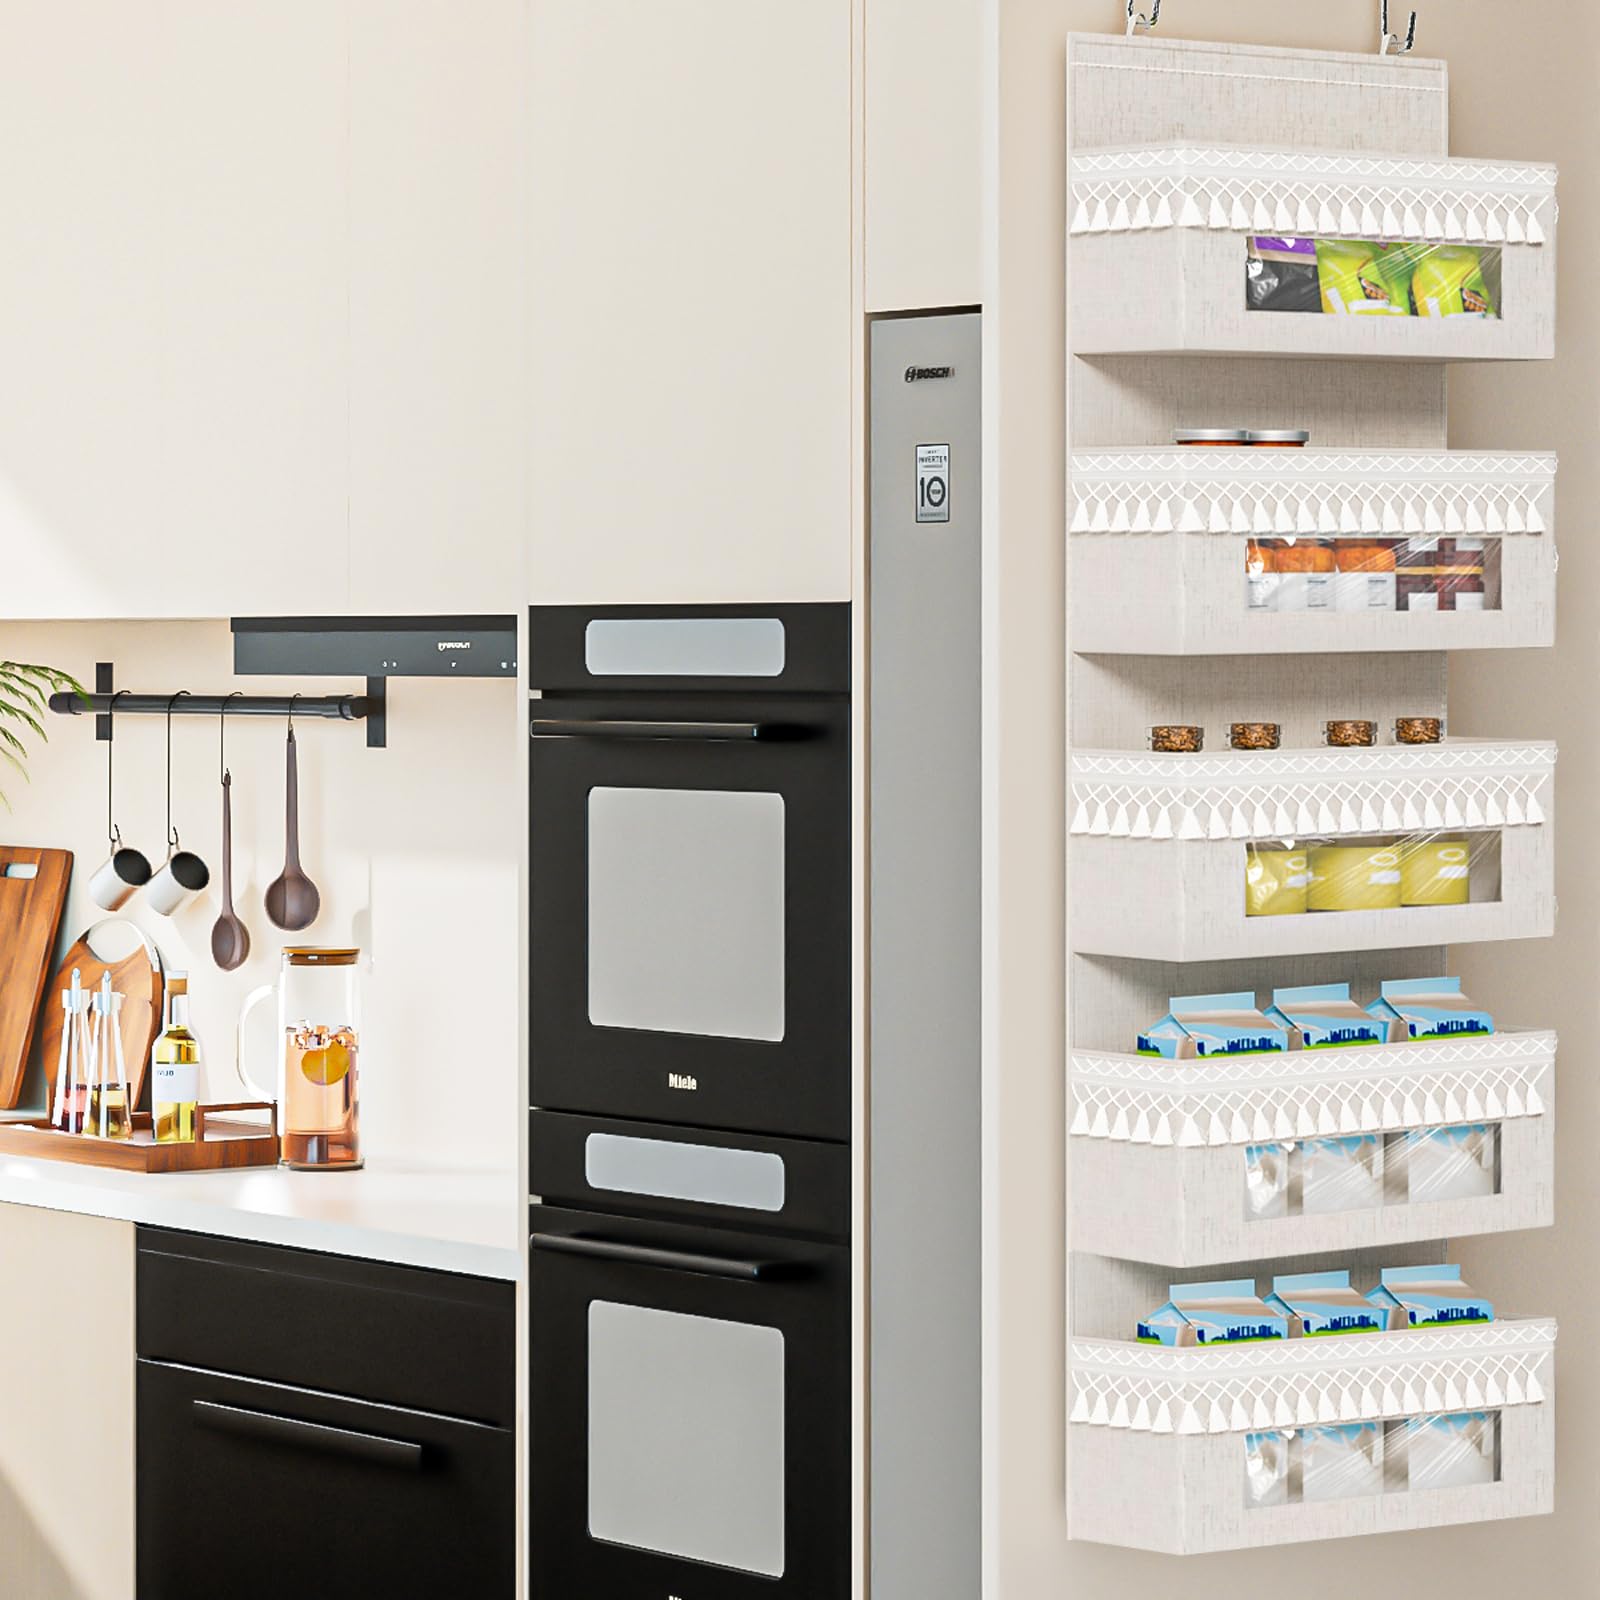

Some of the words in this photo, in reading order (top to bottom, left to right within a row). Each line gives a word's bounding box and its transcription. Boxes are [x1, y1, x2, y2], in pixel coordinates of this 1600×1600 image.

[917, 367, 951, 380] BOSCH
[920, 475, 946, 507] 10
[668, 1072, 697, 1090] Miele
